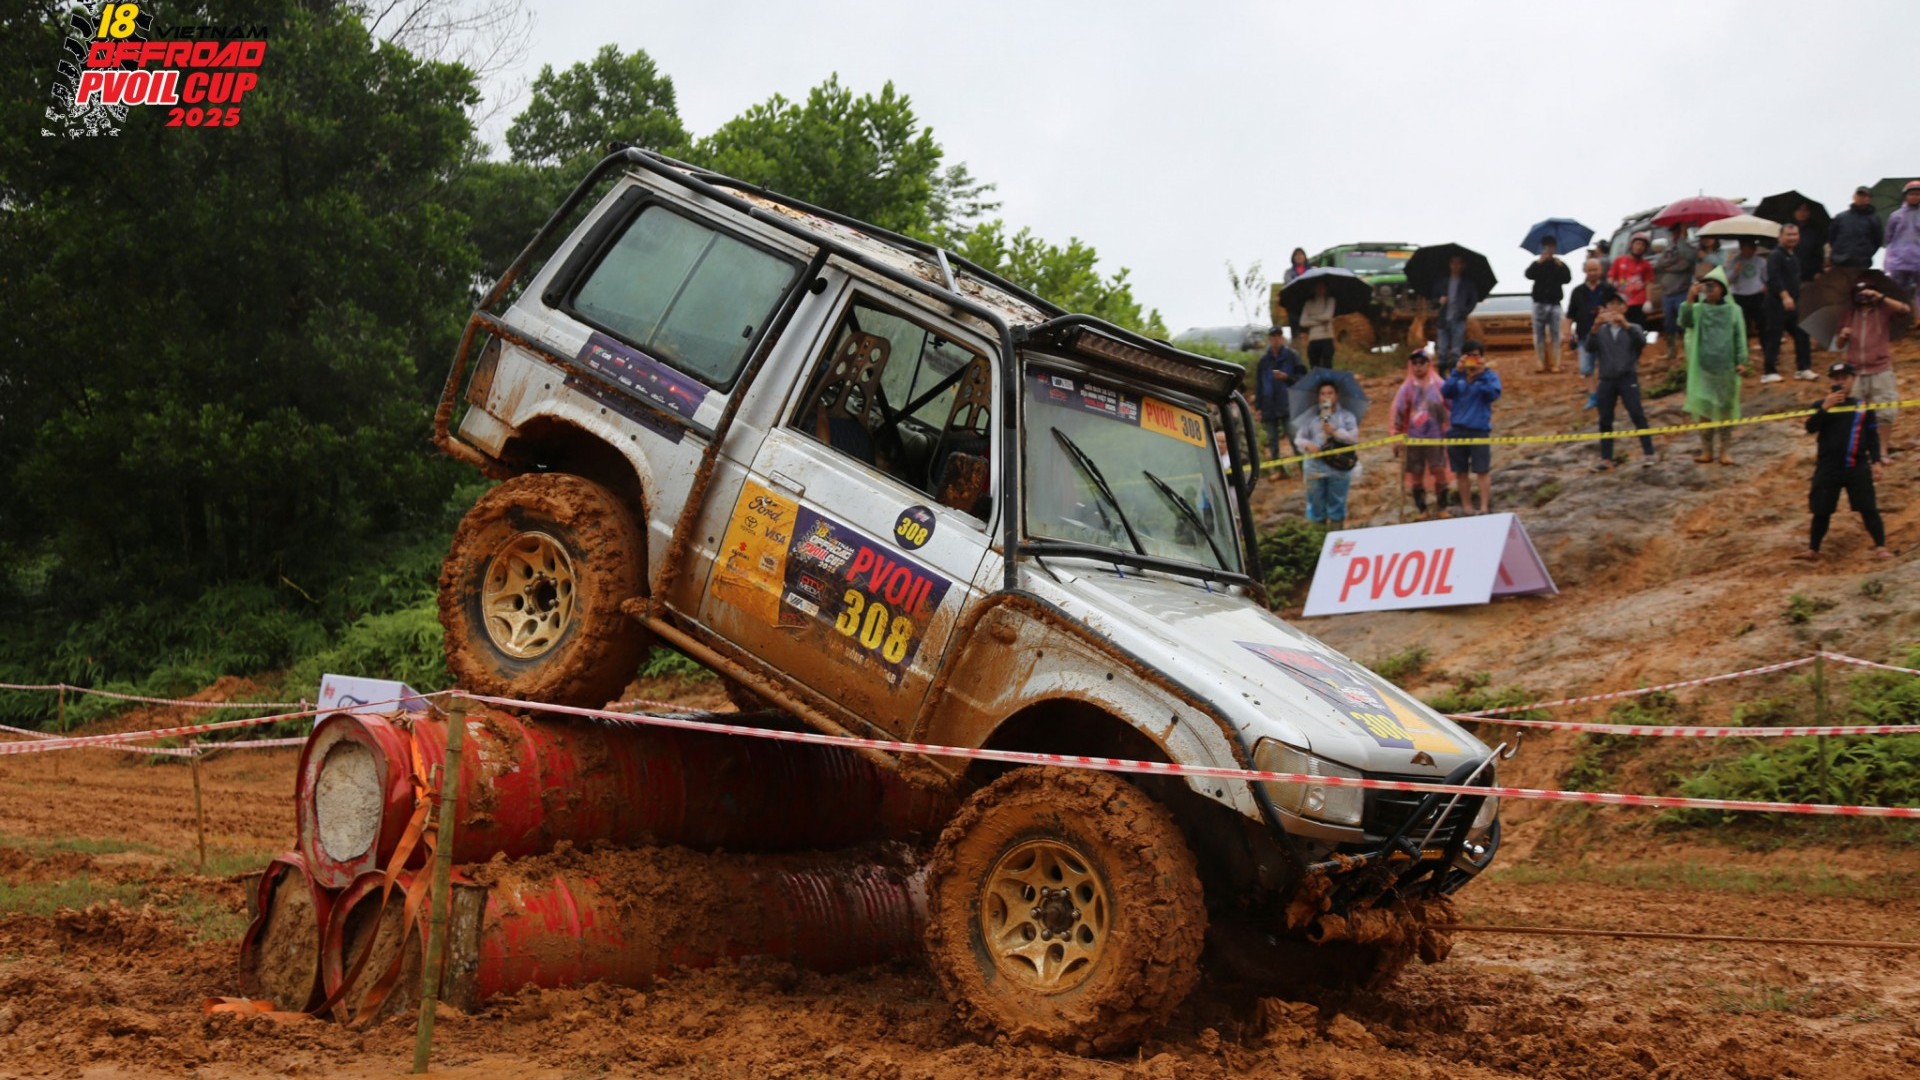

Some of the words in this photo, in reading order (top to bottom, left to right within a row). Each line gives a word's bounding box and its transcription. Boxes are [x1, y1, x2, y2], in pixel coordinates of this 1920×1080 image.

[1145, 401, 1178, 432] PVOIL
[1181, 414, 1202, 441] 308
[748, 496, 784, 523] Ford
[764, 527, 786, 544] VISA
[897, 517, 928, 546] 308
[846, 546, 933, 619] PVOIL
[1338, 547, 1455, 602] PVOIL
[835, 589, 913, 664] 308
